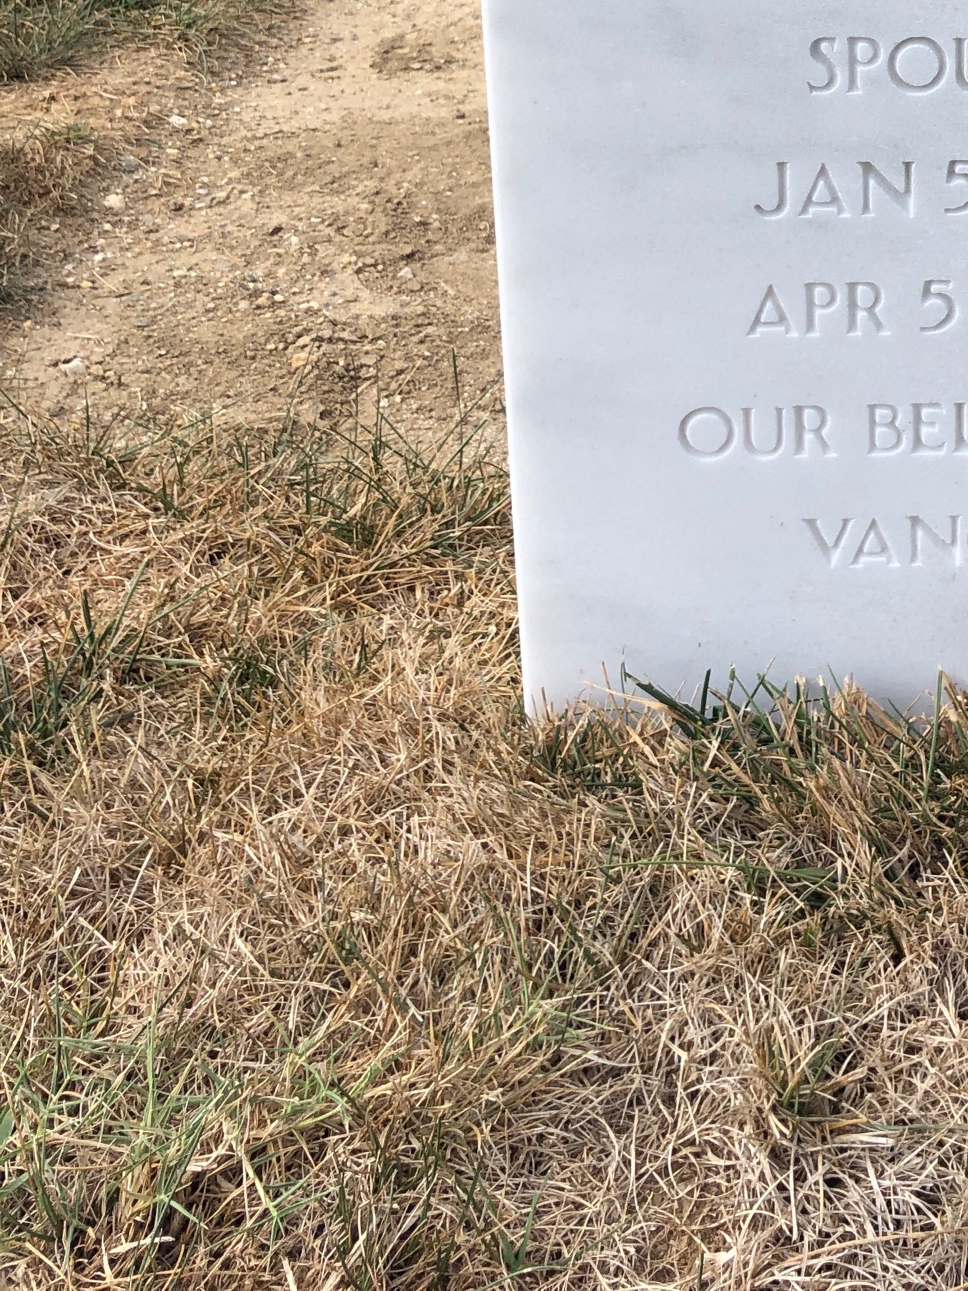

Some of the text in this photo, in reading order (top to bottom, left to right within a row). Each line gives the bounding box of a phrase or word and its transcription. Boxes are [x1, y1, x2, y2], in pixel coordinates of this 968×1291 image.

[754, 159, 915, 218] JAN
[747, 280, 891, 338] APR
[919, 278, 957, 335] 5
[677, 404, 838, 461] OUR
